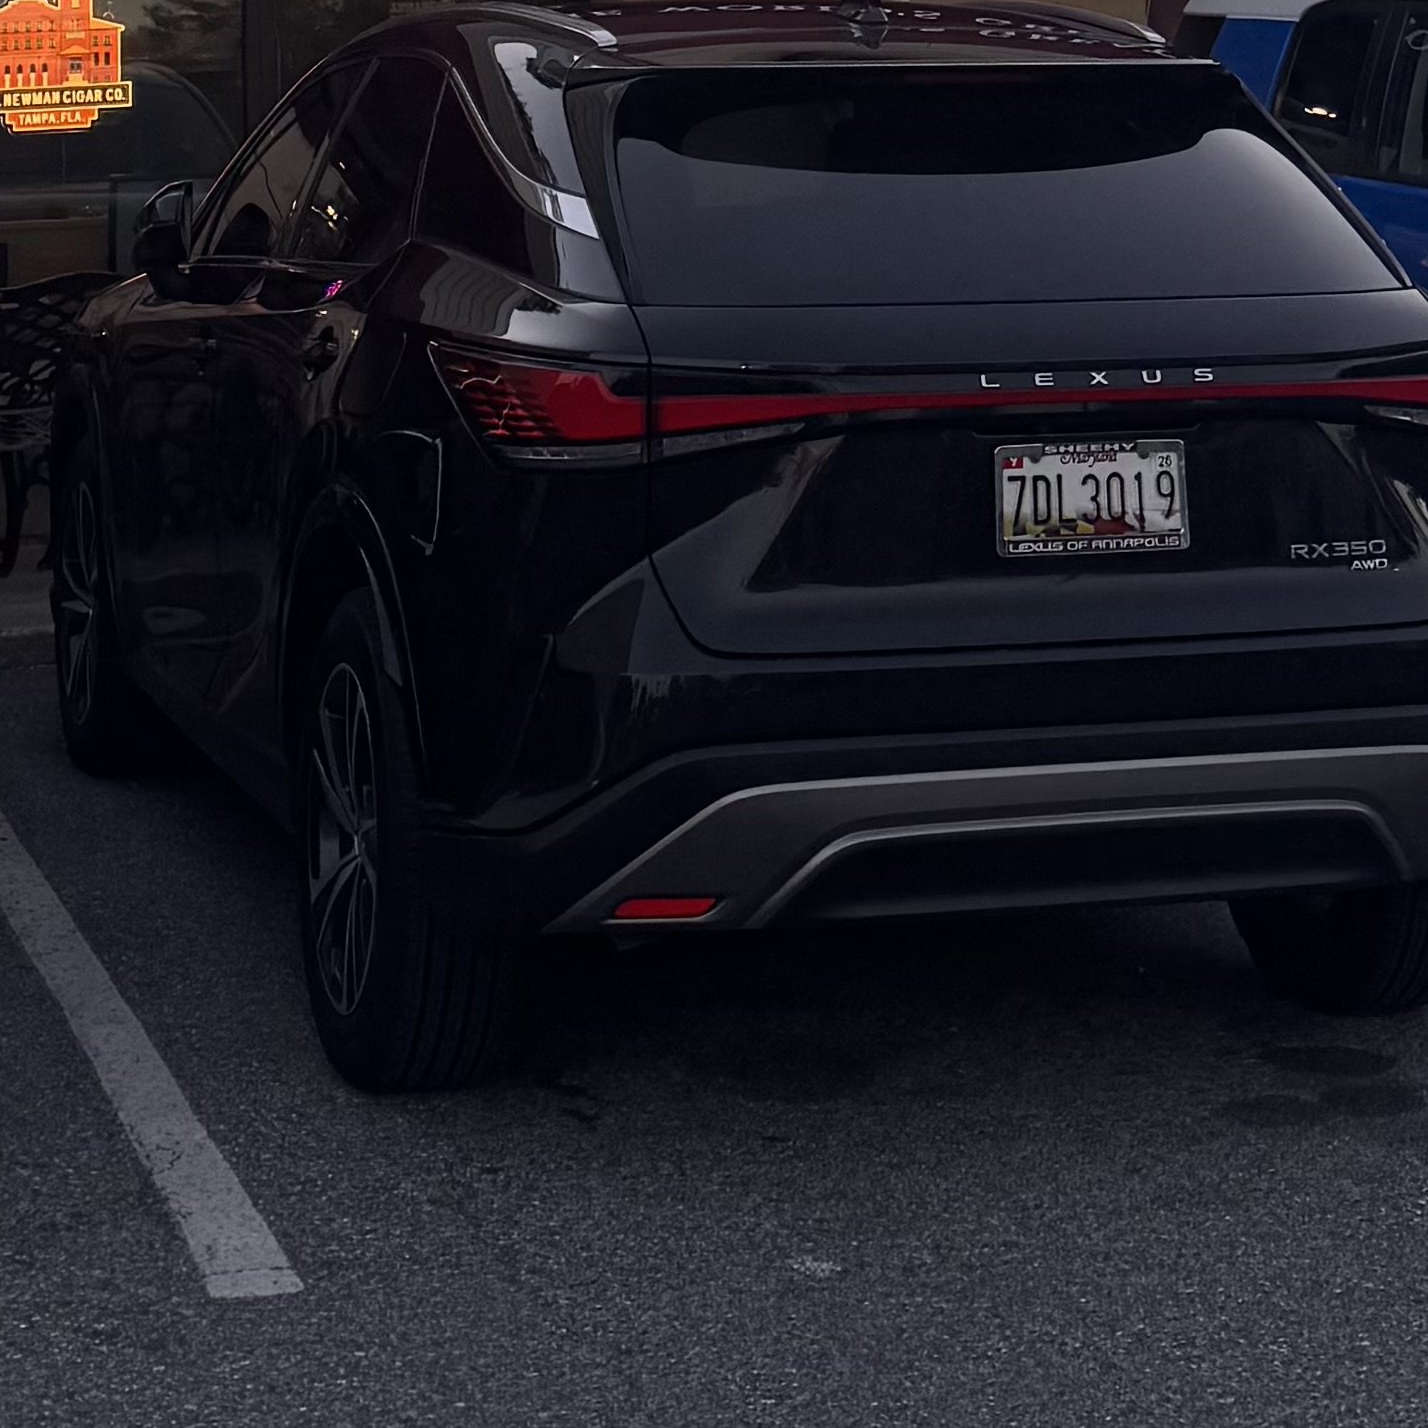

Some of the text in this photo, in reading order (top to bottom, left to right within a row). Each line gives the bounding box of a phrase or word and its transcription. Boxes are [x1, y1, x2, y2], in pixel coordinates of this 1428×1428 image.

[3, 90, 60, 107] NEWMAN
[62, 89, 103, 104] CIGAR
[105, 87, 126, 101] CO.
[980, 368, 1215, 388] LEXUS
[1043, 442, 1135, 455] SHEEHY
[1008, 536, 1180, 553] LEXUS OF ANNAPOLIS
[1350, 558, 1388, 571] AWD
